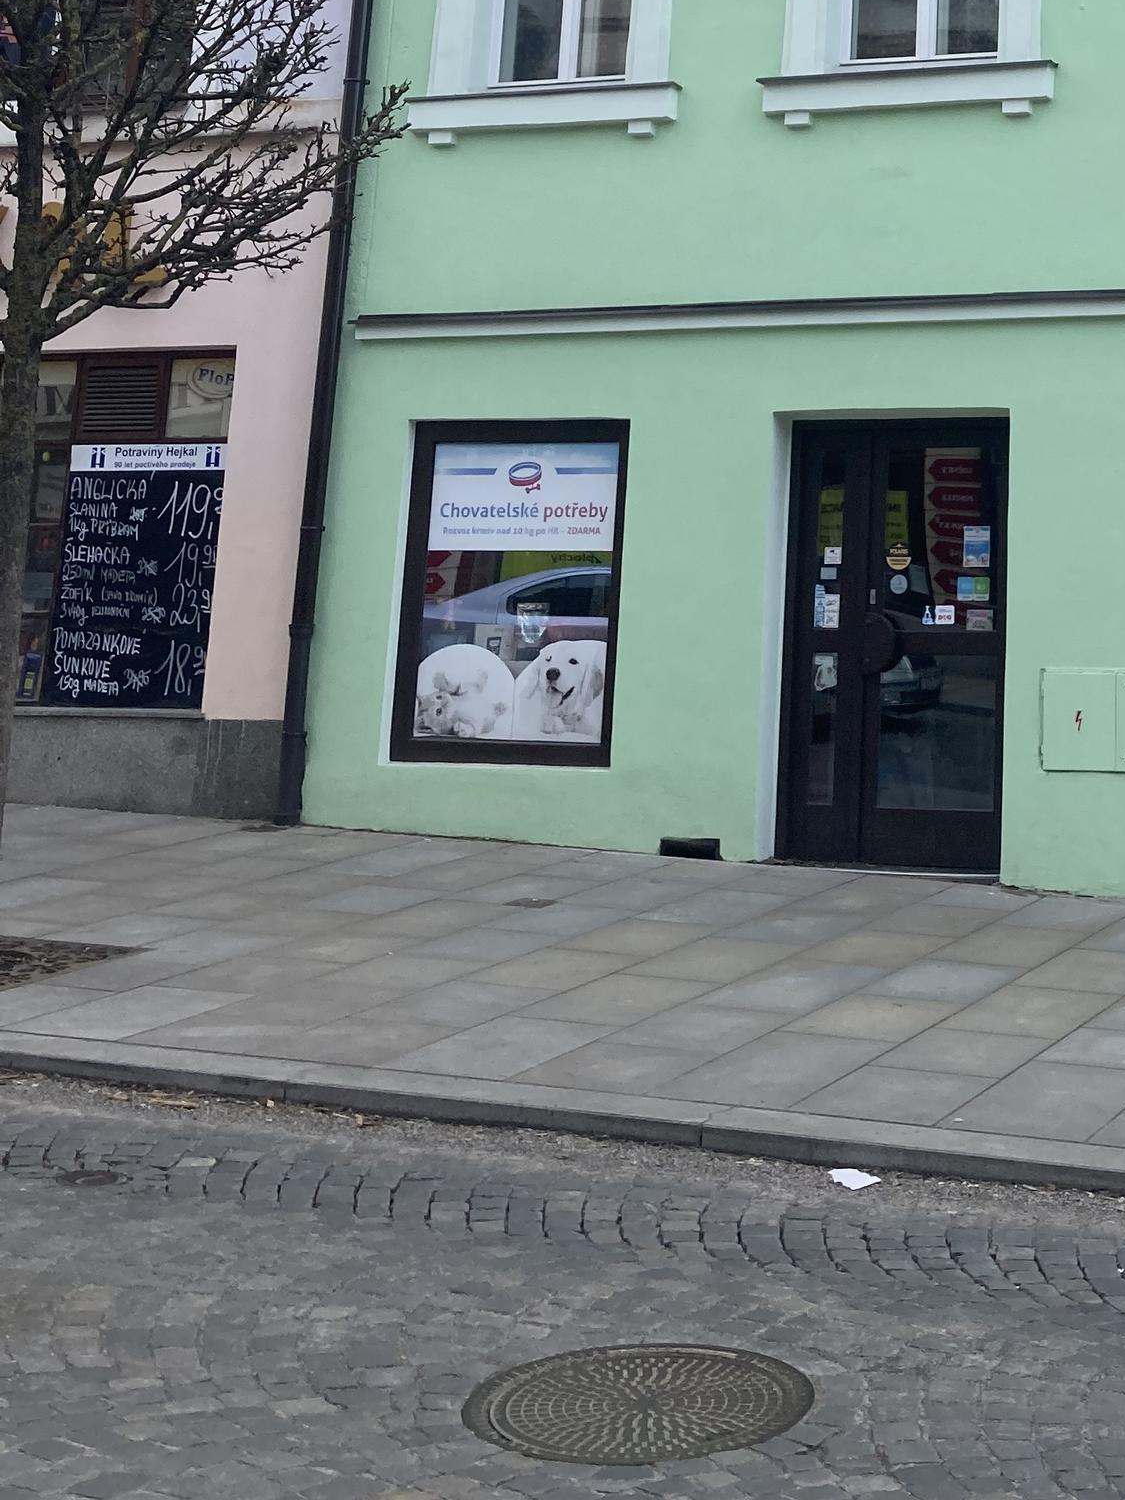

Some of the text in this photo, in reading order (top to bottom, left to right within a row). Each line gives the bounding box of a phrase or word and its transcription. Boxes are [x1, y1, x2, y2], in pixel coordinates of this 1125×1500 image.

[114, 446, 198, 459] Potraviny Hejkal
[440, 502, 608, 522] Chovatelské potřeby
[566, 526, 601, 535] ZDARMA
